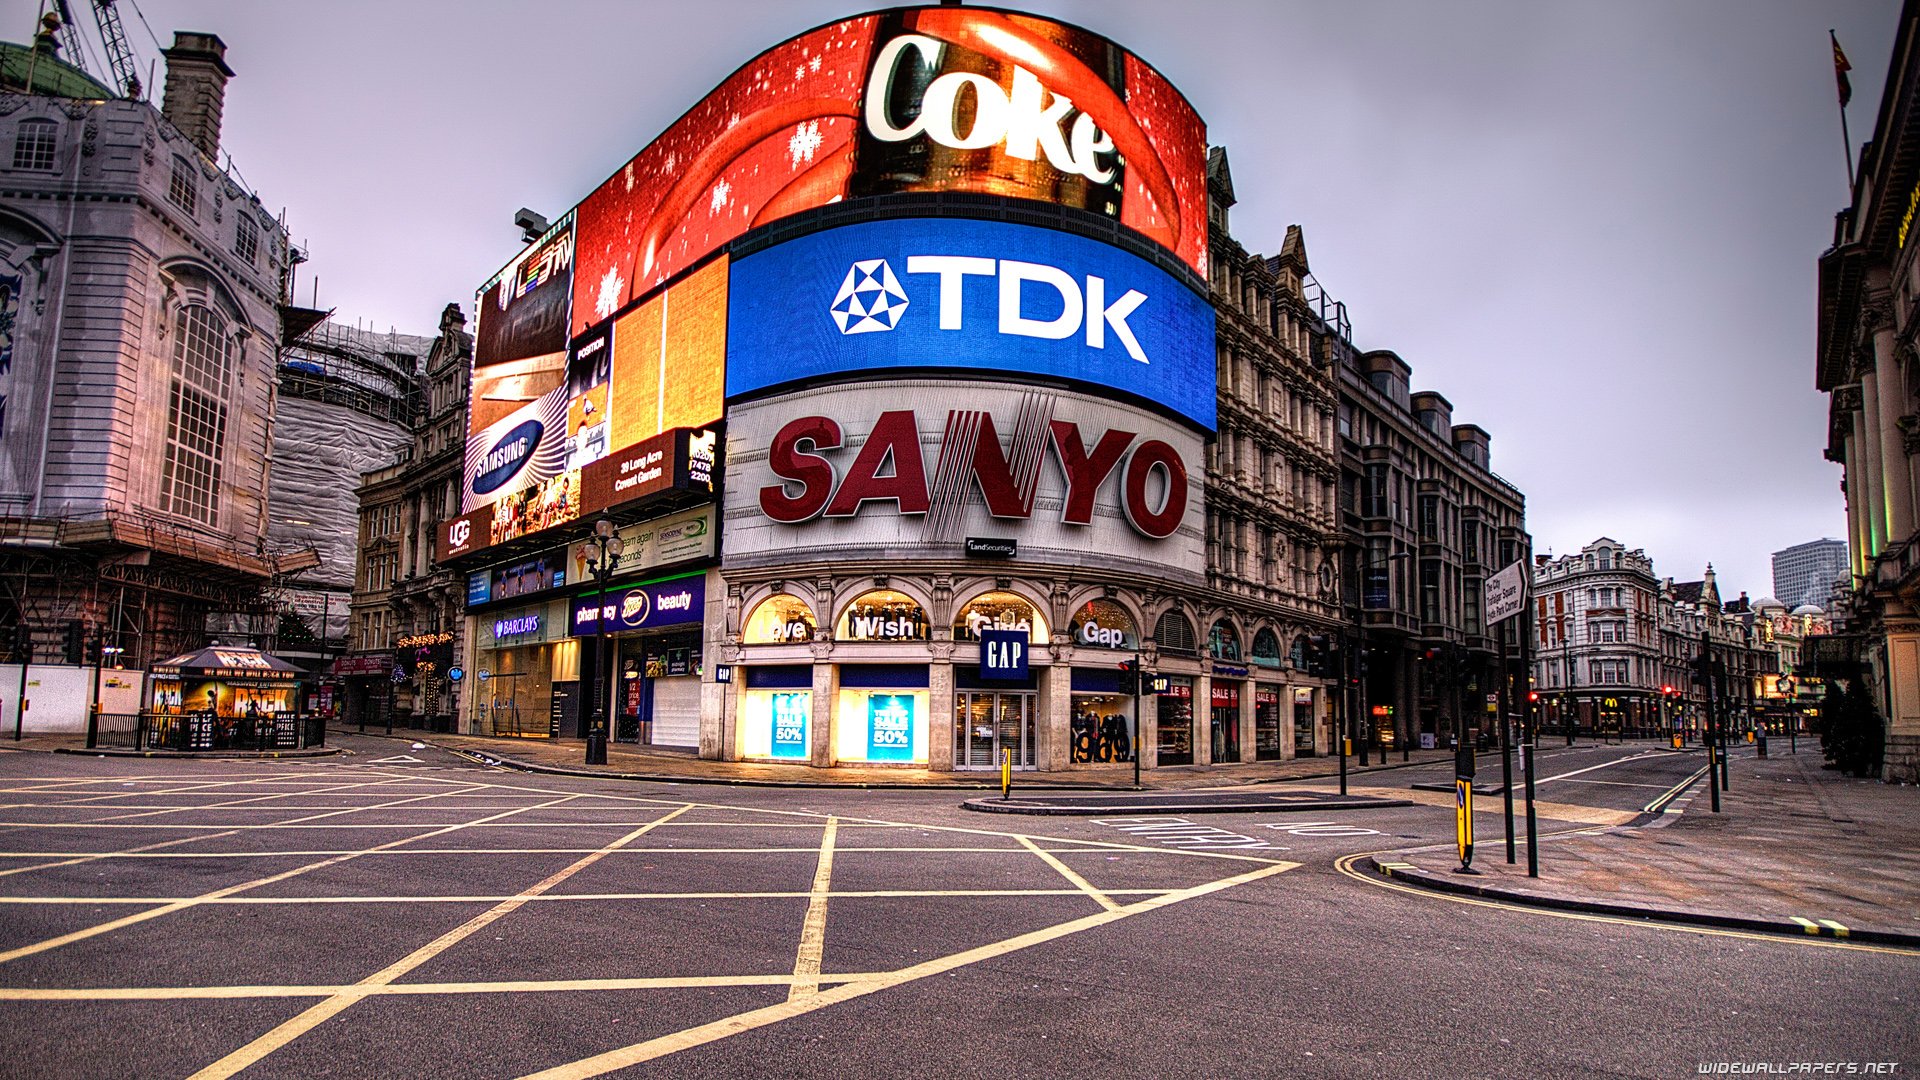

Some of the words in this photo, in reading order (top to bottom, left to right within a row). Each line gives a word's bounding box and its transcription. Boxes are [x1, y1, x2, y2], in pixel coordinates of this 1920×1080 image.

[865, 34, 1117, 185] Coke
[907, 255, 1150, 365] TDK
[476, 436, 528, 478] SAMSUNG
[620, 461, 630, 474] 39
[630, 456, 647, 471] Long
[647, 450, 663, 465] Acre
[759, 388, 1189, 542] SANYO
[615, 473, 637, 491] Covent
[638, 467, 662, 484] Garden
[690, 470, 711, 483] 2200
[449, 519, 471, 547] UGG
[637, 530, 654, 546] again
[657, 590, 692, 611] beauty
[503, 615, 539, 635] BARCLAYS
[758, 618, 806, 639] Love
[855, 616, 914, 637] Wish
[1083, 621, 1123, 649] Gap
[987, 640, 1022, 669] GAP
[718, 668, 730, 680] GAP
[1212, 687, 1229, 700] SALE
[1257, 692, 1269, 702] SALE
[776, 728, 803, 741] 50%
[873, 730, 909, 744] 50%
